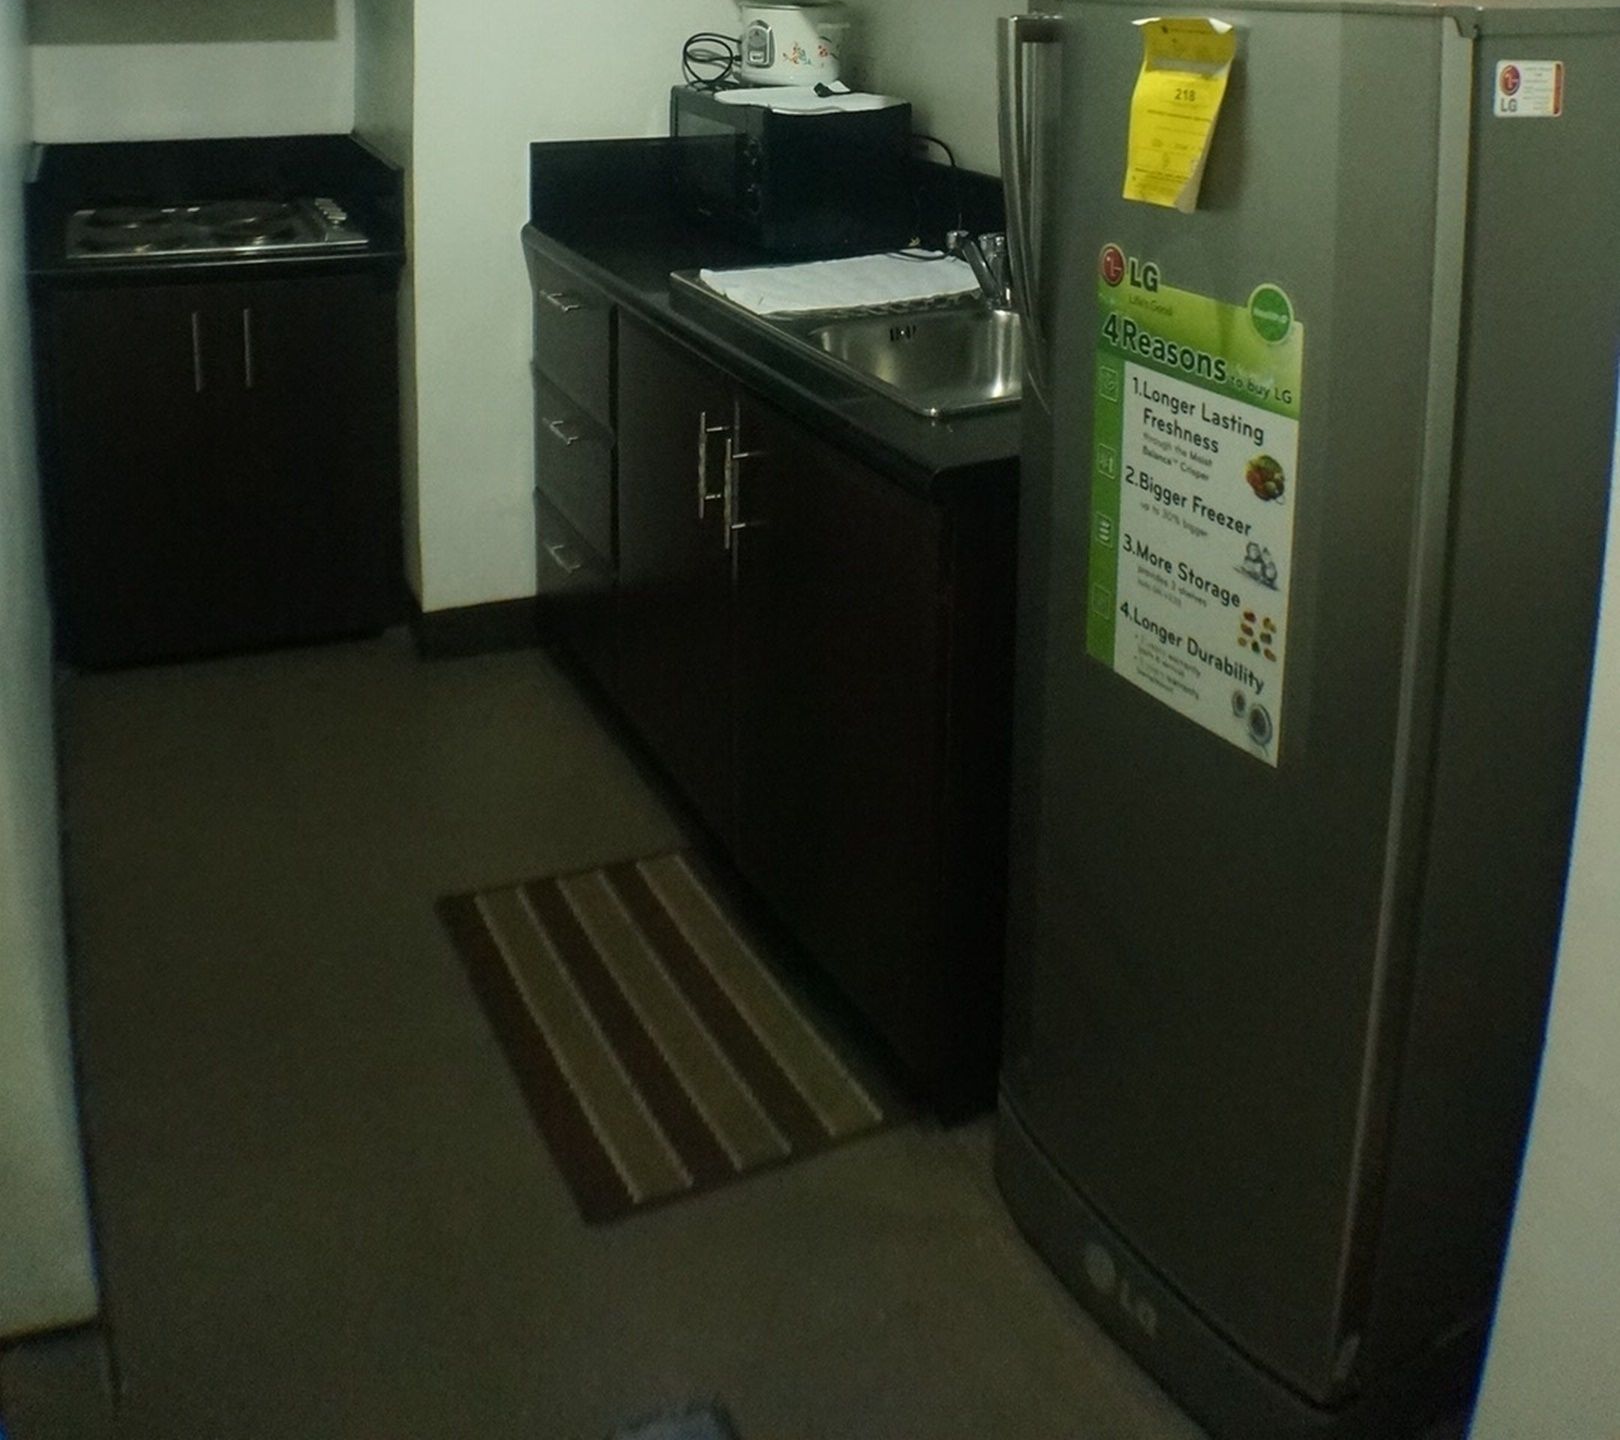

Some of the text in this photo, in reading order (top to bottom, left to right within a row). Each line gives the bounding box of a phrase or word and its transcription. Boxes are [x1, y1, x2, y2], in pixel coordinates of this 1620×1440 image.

[1174, 88, 1196, 102] 218
[1500, 98, 1518, 112] LG
[1128, 257, 1160, 293] LG
[1103, 313, 1292, 404] 4 Reasons to buy LG
[1143, 408, 1219, 453] Freshness
[1201, 402, 1264, 446] Lasting
[1192, 495, 1252, 536] Freezer
[1178, 562, 1241, 608] Storage
[1187, 636, 1264, 695] Durability
